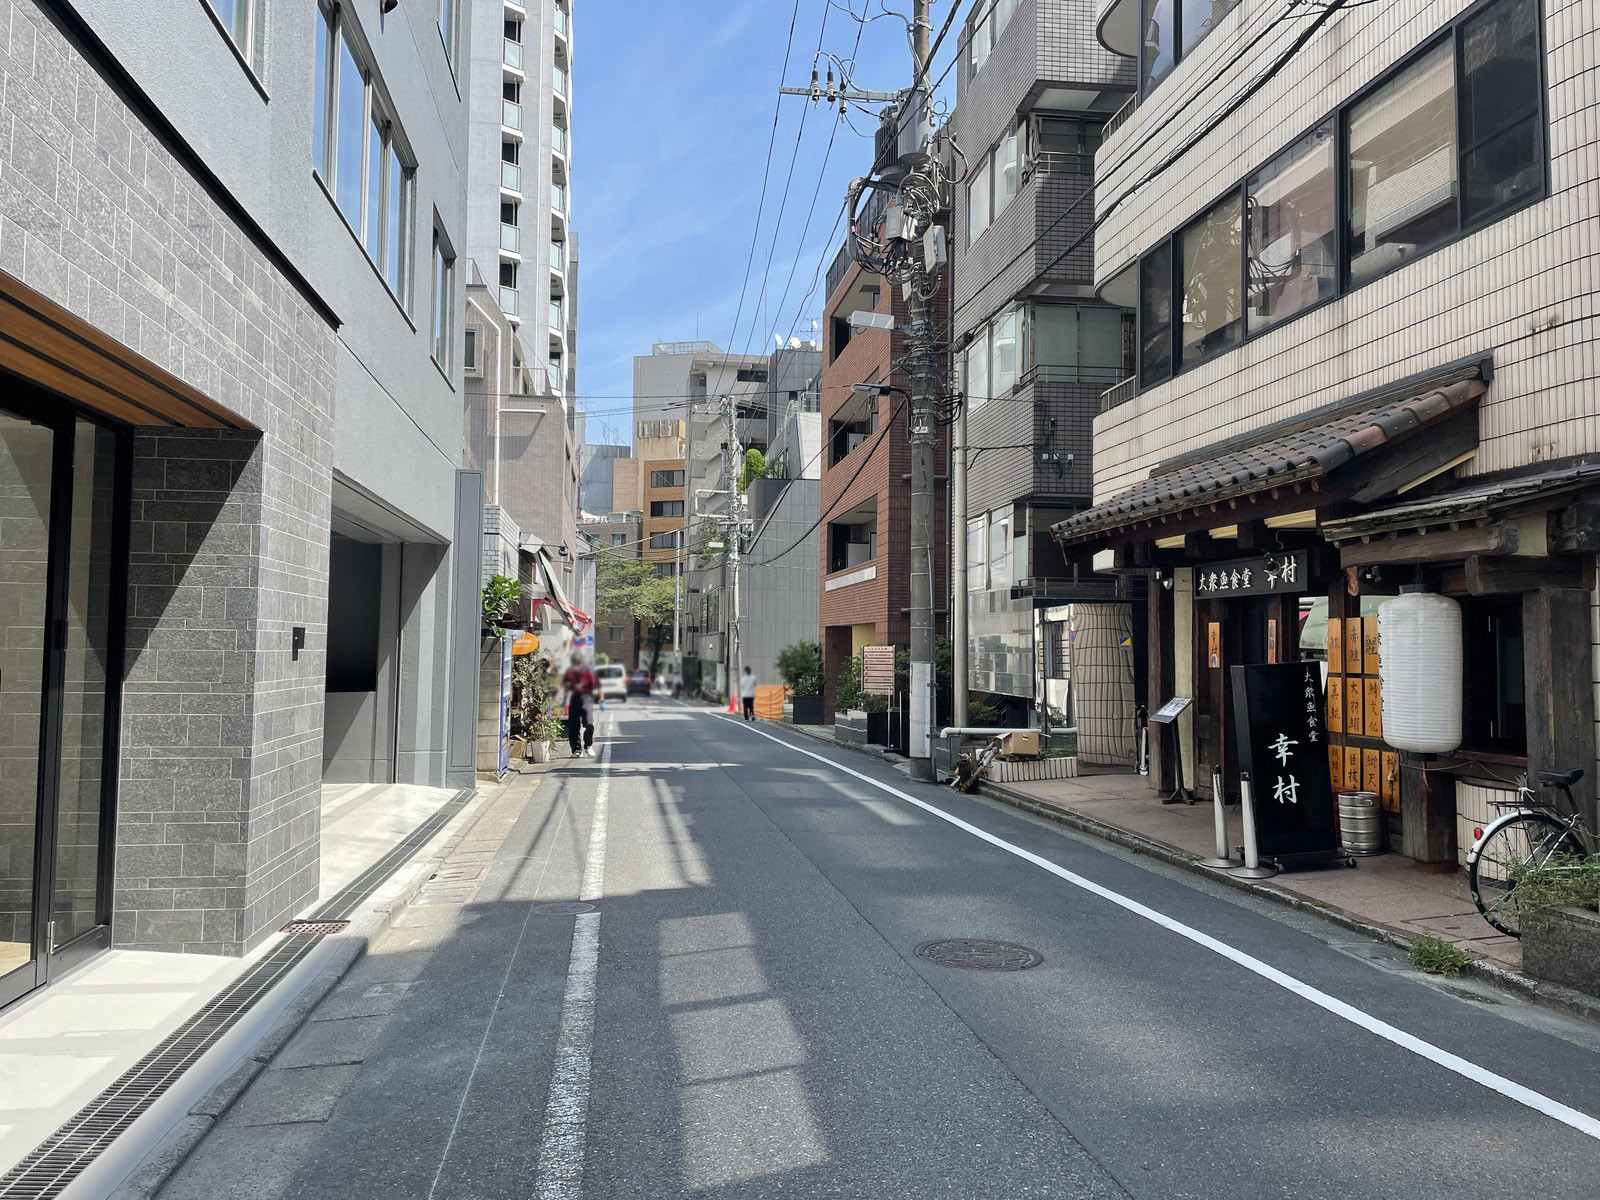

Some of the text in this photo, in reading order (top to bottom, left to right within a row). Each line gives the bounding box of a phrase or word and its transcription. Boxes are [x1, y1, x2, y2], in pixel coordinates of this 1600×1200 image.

[1198, 567, 1253, 592] 大衆魚食堂
[1304, 671, 1319, 743] 大衆魚食堂
[1267, 733, 1301, 804] 幸村
